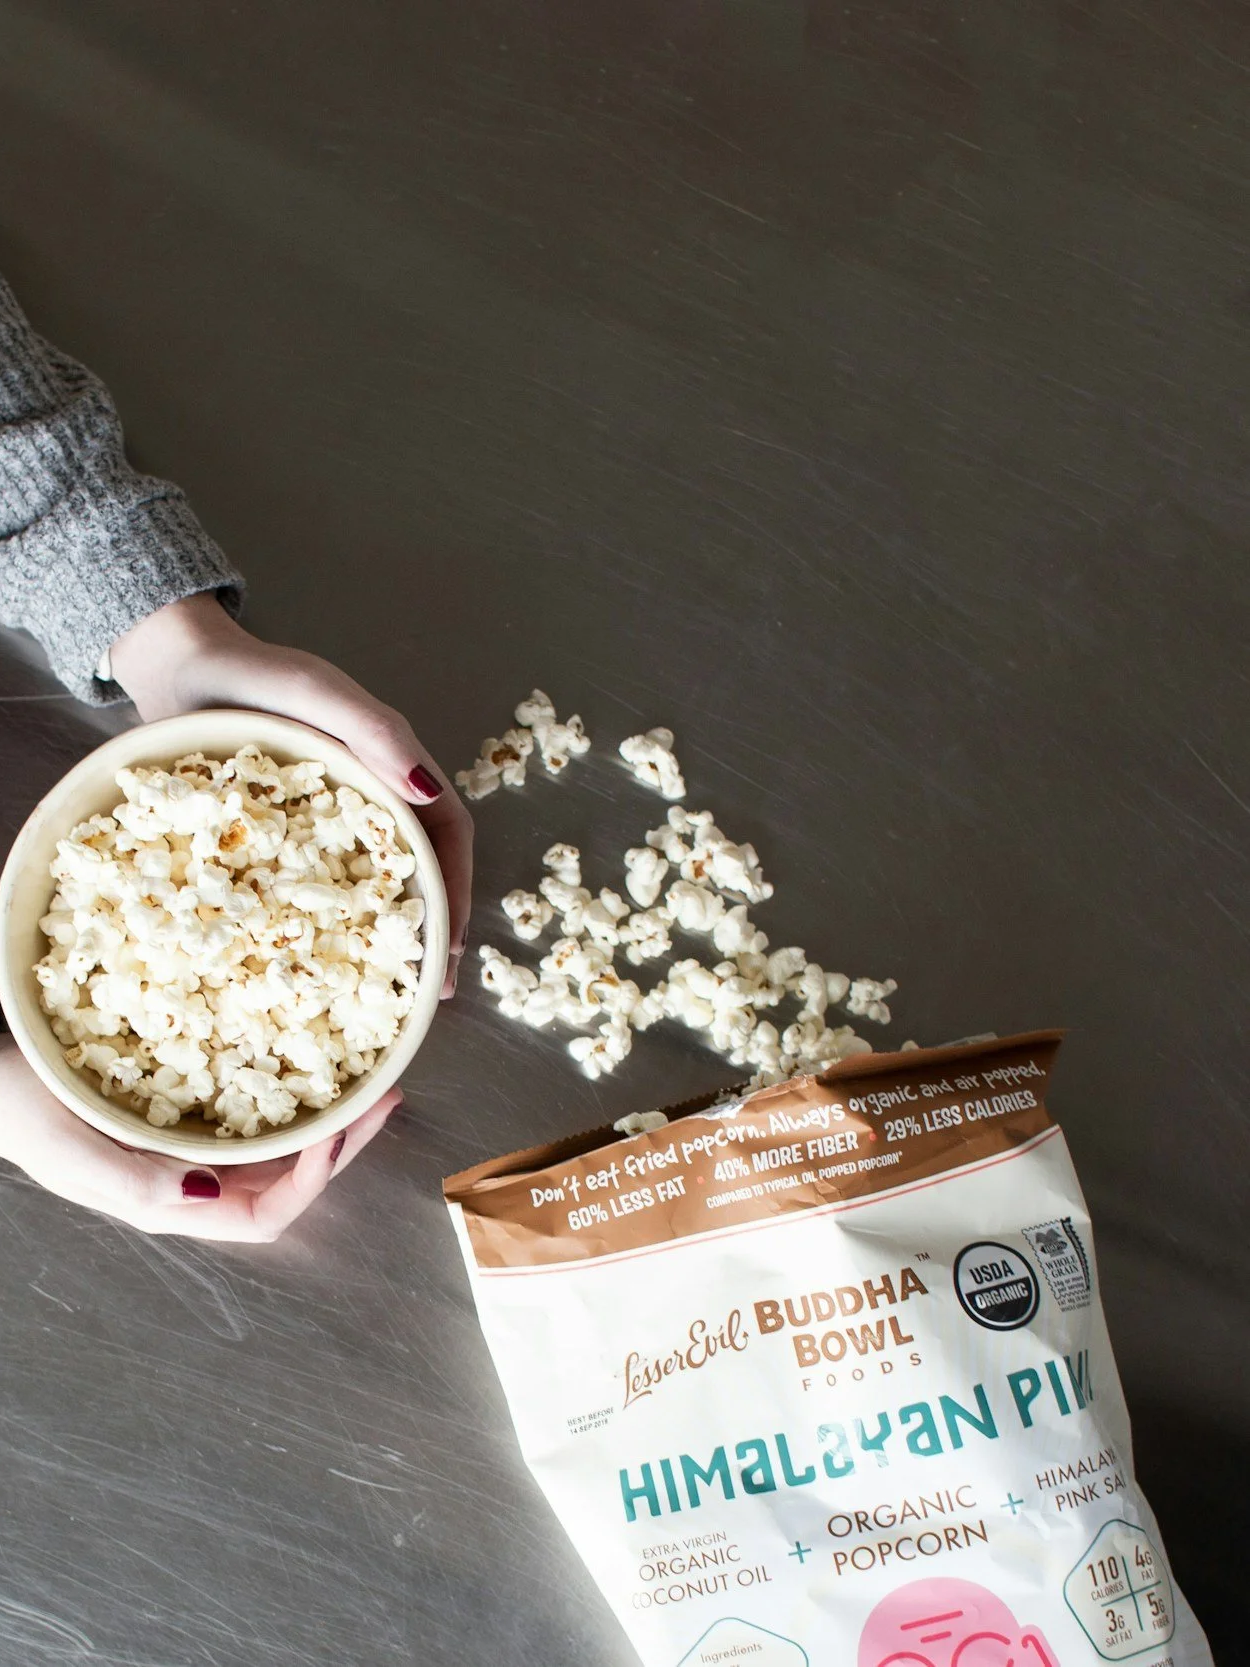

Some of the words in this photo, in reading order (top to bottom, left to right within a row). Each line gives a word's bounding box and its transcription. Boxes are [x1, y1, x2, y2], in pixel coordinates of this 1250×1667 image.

[530, 1176, 580, 1208] Don't
[585, 1163, 619, 1191] eat
[624, 1151, 678, 1177] fried
[768, 1103, 845, 1135] Always
[921, 1076, 953, 1099] and
[957, 1072, 981, 1091] air
[984, 1060, 1046, 1088] popped.
[568, 1206, 609, 1230] 60%
[609, 1188, 652, 1218] LESS
[656, 1175, 687, 1202] FAT
[713, 1157, 750, 1183] 40%
[752, 1144, 804, 1173] MORE
[807, 1130, 859, 1159] FIBER
[885, 1116, 921, 1142] 29%
[922, 1105, 963, 1132] LESS
[964, 1090, 1037, 1122] CALORIES
[706, 1186, 752, 1209] COMPARED
[751, 1184, 763, 1198] TO
[763, 1173, 801, 1195] TYPICAL
[802, 1169, 818, 1184] OIL
[819, 1162, 857, 1180] POPPED
[969, 1259, 1014, 1285] USDA
[1045, 1255, 1077, 1269] WHOLE
[1051, 1264, 1078, 1278] GRAIN
[753, 1267, 929, 1335] BUDDHA
[975, 1282, 1029, 1310] ORGANIC
[792, 1315, 914, 1368] BOWL
[802, 1353, 922, 1391] FOODS
[1036, 1448, 1116, 1490] HIMALAY
[827, 1485, 977, 1538] ORGANIC
[1055, 1483, 1101, 1512] PINK
[643, 1542, 680, 1560] EXTRA
[683, 1531, 728, 1551] VIRGIN
[833, 1520, 989, 1576] POPCORN
[639, 1544, 741, 1582] ORGANIC
[1087, 1556, 1119, 1587] 110
[1141, 1570, 1155, 1581] FAT
[631, 1573, 728, 1610] COCONUT
[737, 1565, 772, 1587] OIL
[1091, 1582, 1125, 1601] CALORIES
[700, 1643, 763, 1664] Ingredients
[1106, 1635, 1119, 1648] SAT
[1120, 1629, 1133, 1643] FAT
